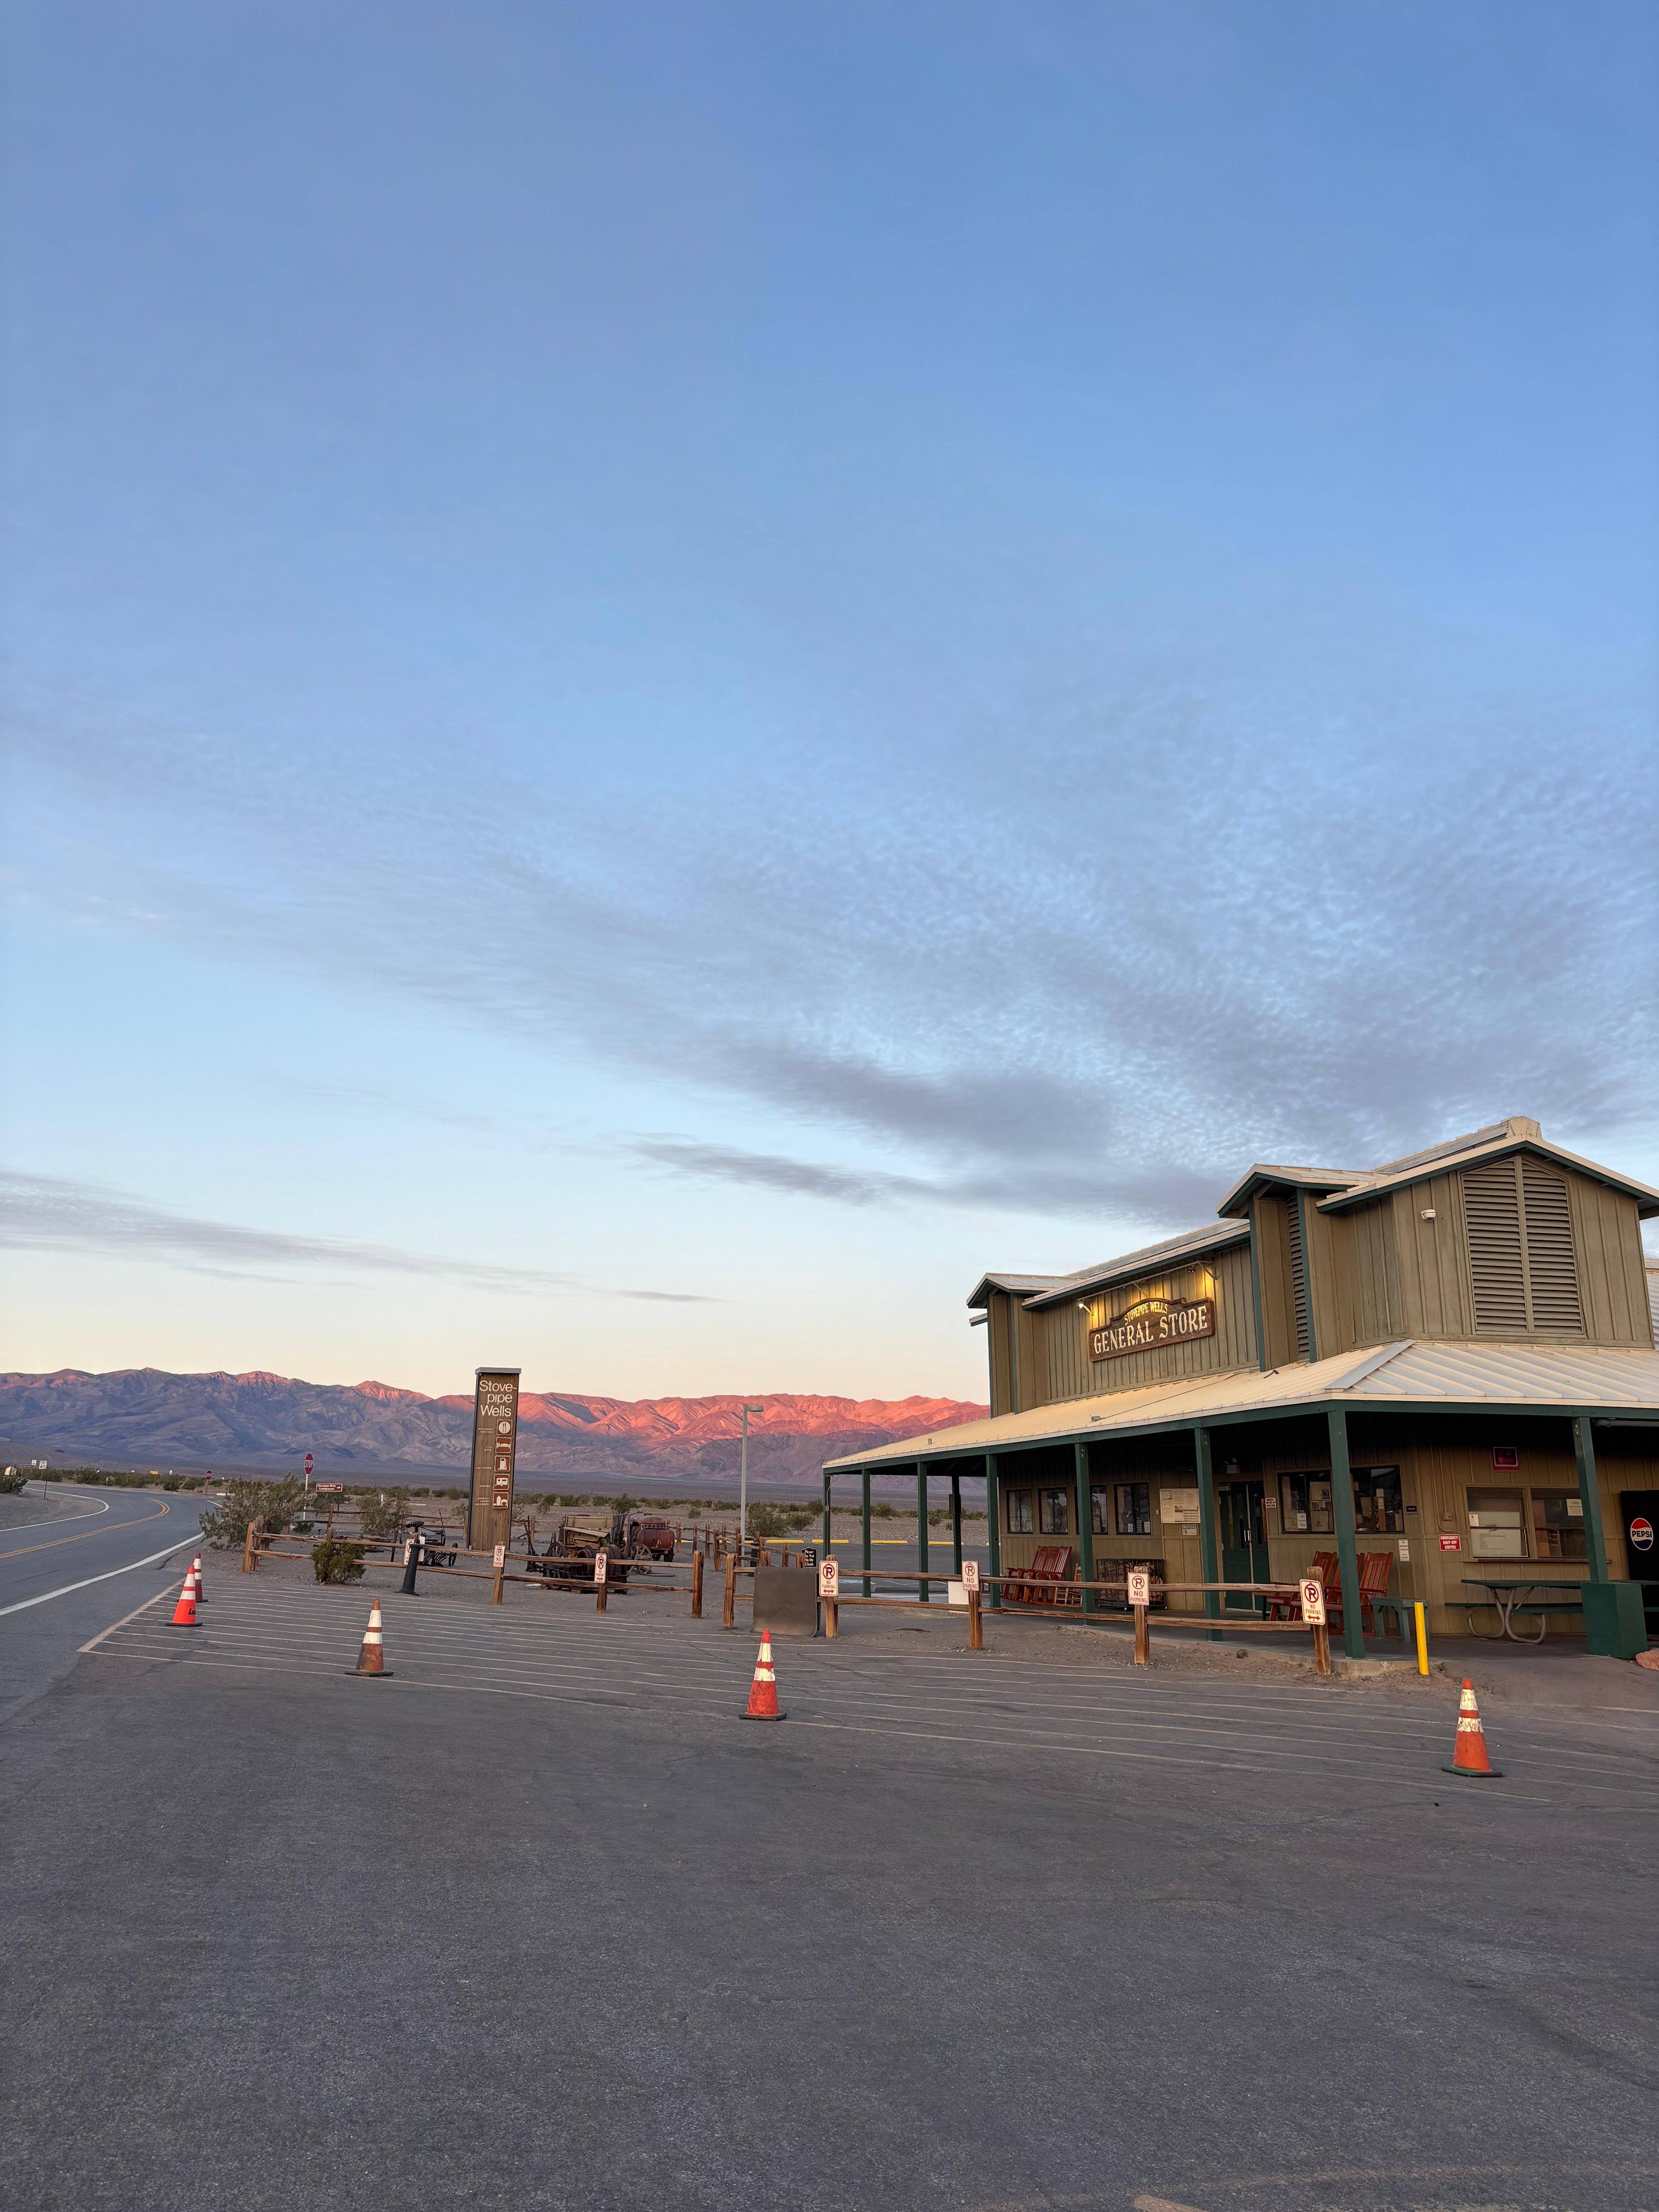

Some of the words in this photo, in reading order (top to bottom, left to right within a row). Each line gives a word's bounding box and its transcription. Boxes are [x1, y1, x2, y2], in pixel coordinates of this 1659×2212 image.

[1124, 1303, 1149, 1324] STOVEPIPE
[1149, 1301, 1168, 1314] WELLS
[1094, 1321, 1154, 1354] GENERAL
[1159, 1305, 1207, 1338] STORE
[479, 1380, 517, 1392] Stove-
[487, 1394, 513, 1405] pipe
[480, 1405, 512, 1417] Wells
[305, 1460, 313, 1468] STOP
